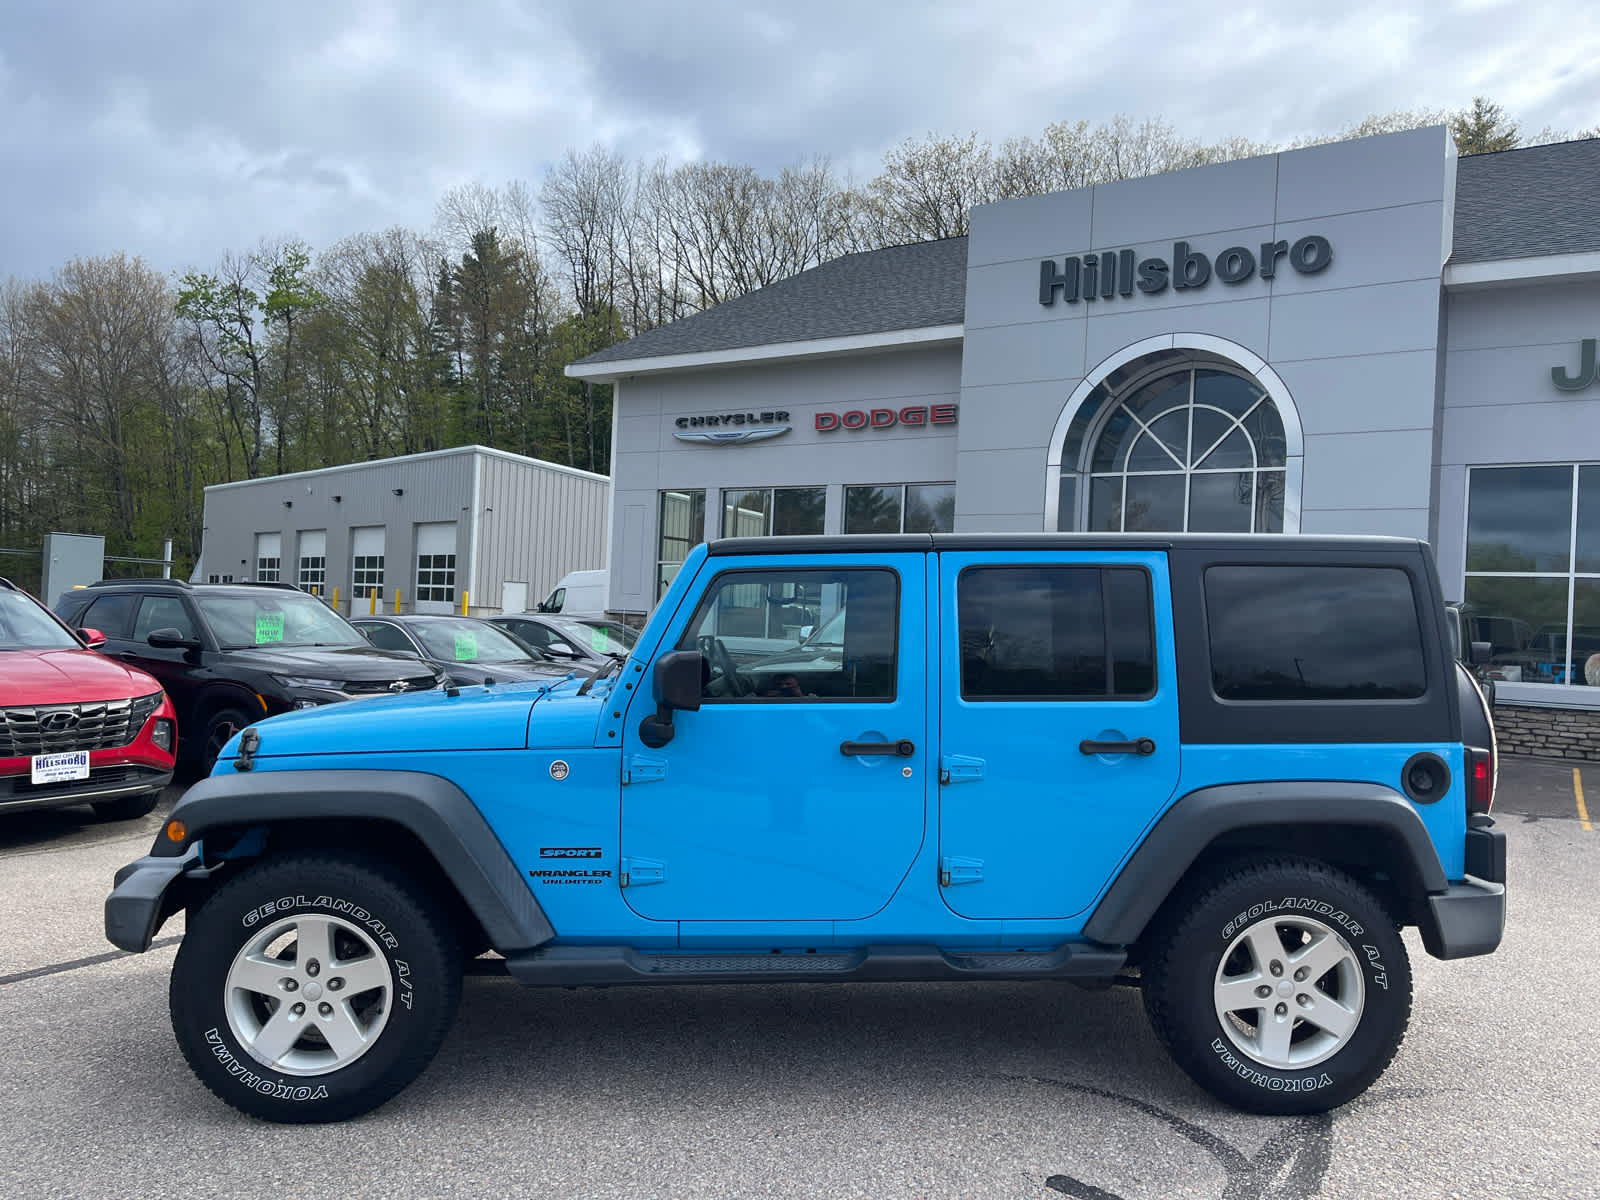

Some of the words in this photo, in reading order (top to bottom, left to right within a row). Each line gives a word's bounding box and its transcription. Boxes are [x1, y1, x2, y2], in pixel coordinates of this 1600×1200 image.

[1039, 235, 1333, 305] Hillsboro
[1551, 337, 1600, 392] J
[675, 411, 791, 428] CHRYSLER
[814, 404, 958, 431] DODGE
[35, 754, 87, 770] HILLSBORO
[528, 870, 612, 878] WRANGLER
[540, 849, 601, 857] SPORT
[242, 895, 399, 950] GEOLANDAR
[395, 958, 415, 1010] A/T
[1221, 897, 1365, 939] GEOLANDAR
[1362, 944, 1388, 990] A/T
[204, 1027, 329, 1101] YOKOHAMA
[1210, 1038, 1334, 1092] YOKOHAMA
